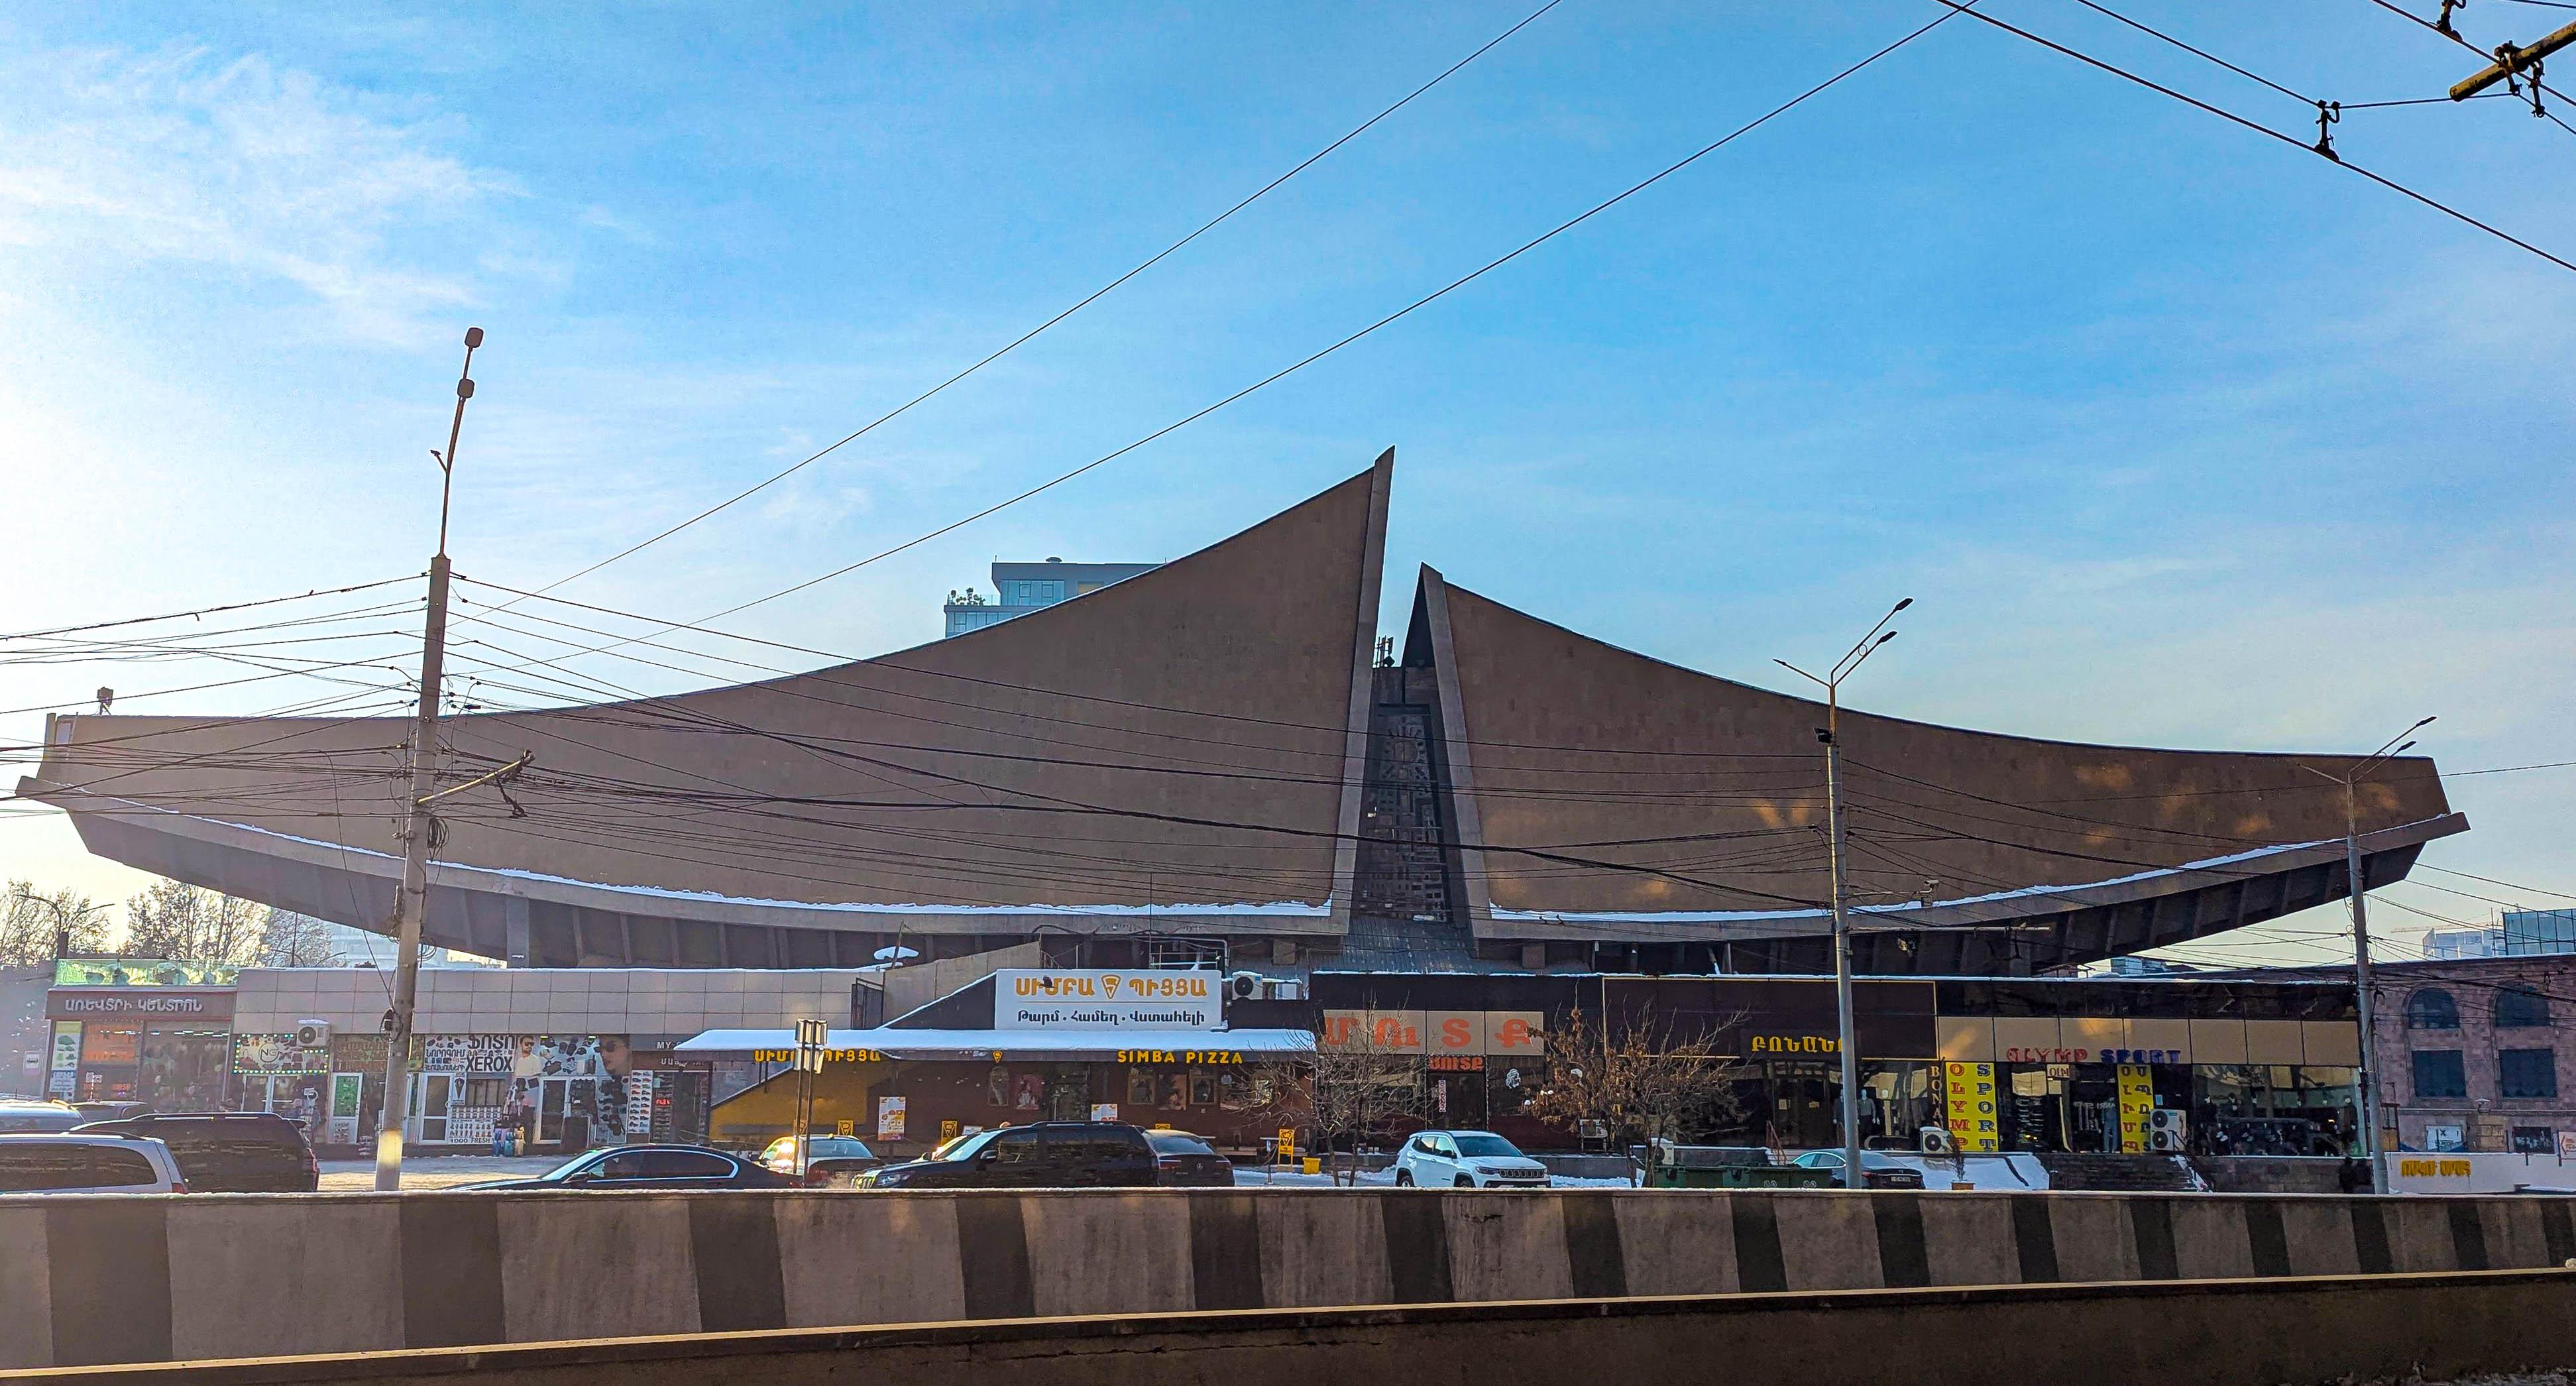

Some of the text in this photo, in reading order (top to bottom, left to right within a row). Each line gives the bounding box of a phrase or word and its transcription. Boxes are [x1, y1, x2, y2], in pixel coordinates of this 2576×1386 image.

[1129, 978, 1207, 997] ՊԻՑՑԱ
[138, 998, 202, 1012] ԿԵՆՏՐՈՆ
[1018, 1010, 1205, 1026] Թարմ Համեղ Վստահելի
[754, 1050, 795, 1061] ՍԻՄ
[1117, 1050, 1243, 1065] SIMBA PIZZA
[2007, 1047, 2181, 1064] OLYMP SPORT
[465, 1056, 512, 1072] XEROX
[1949, 1063, 1971, 1152] OLYMP
[1976, 1064, 1996, 1151] SPORT
